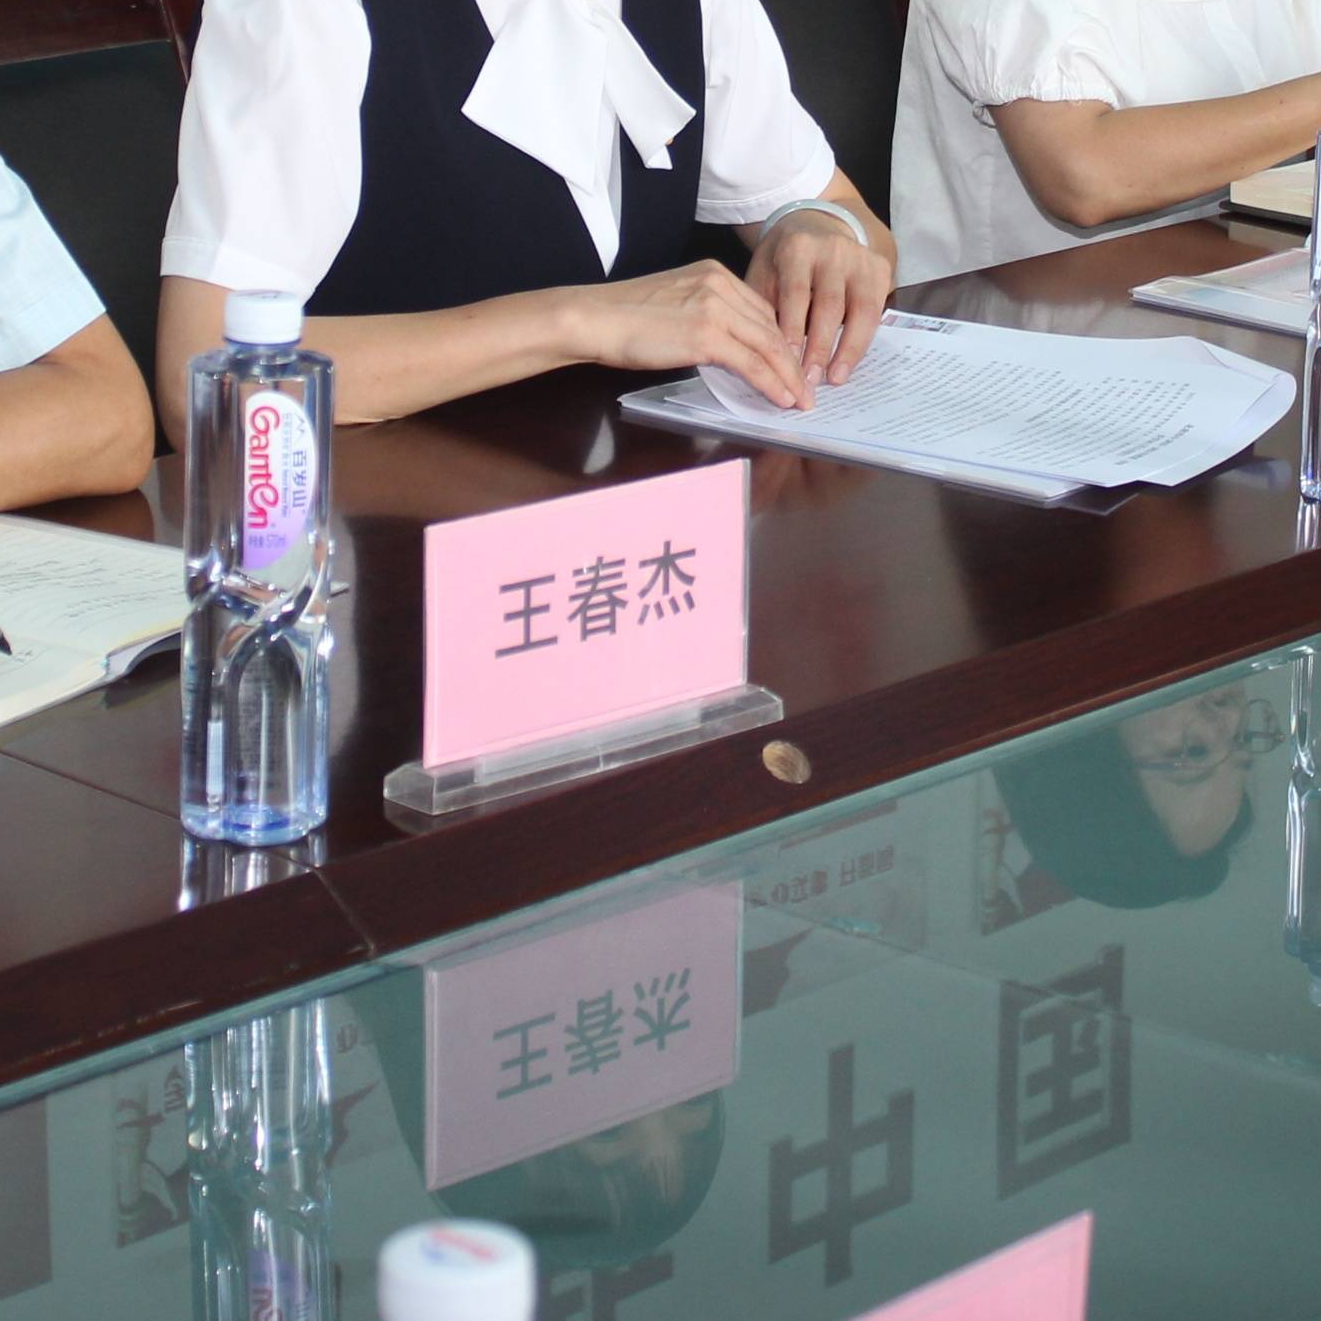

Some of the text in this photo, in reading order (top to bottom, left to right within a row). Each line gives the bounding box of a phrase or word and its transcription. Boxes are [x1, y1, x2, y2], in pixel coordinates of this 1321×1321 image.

[293, 450, 307, 508] 百岁山
[493, 539, 698, 660] 王春杰
